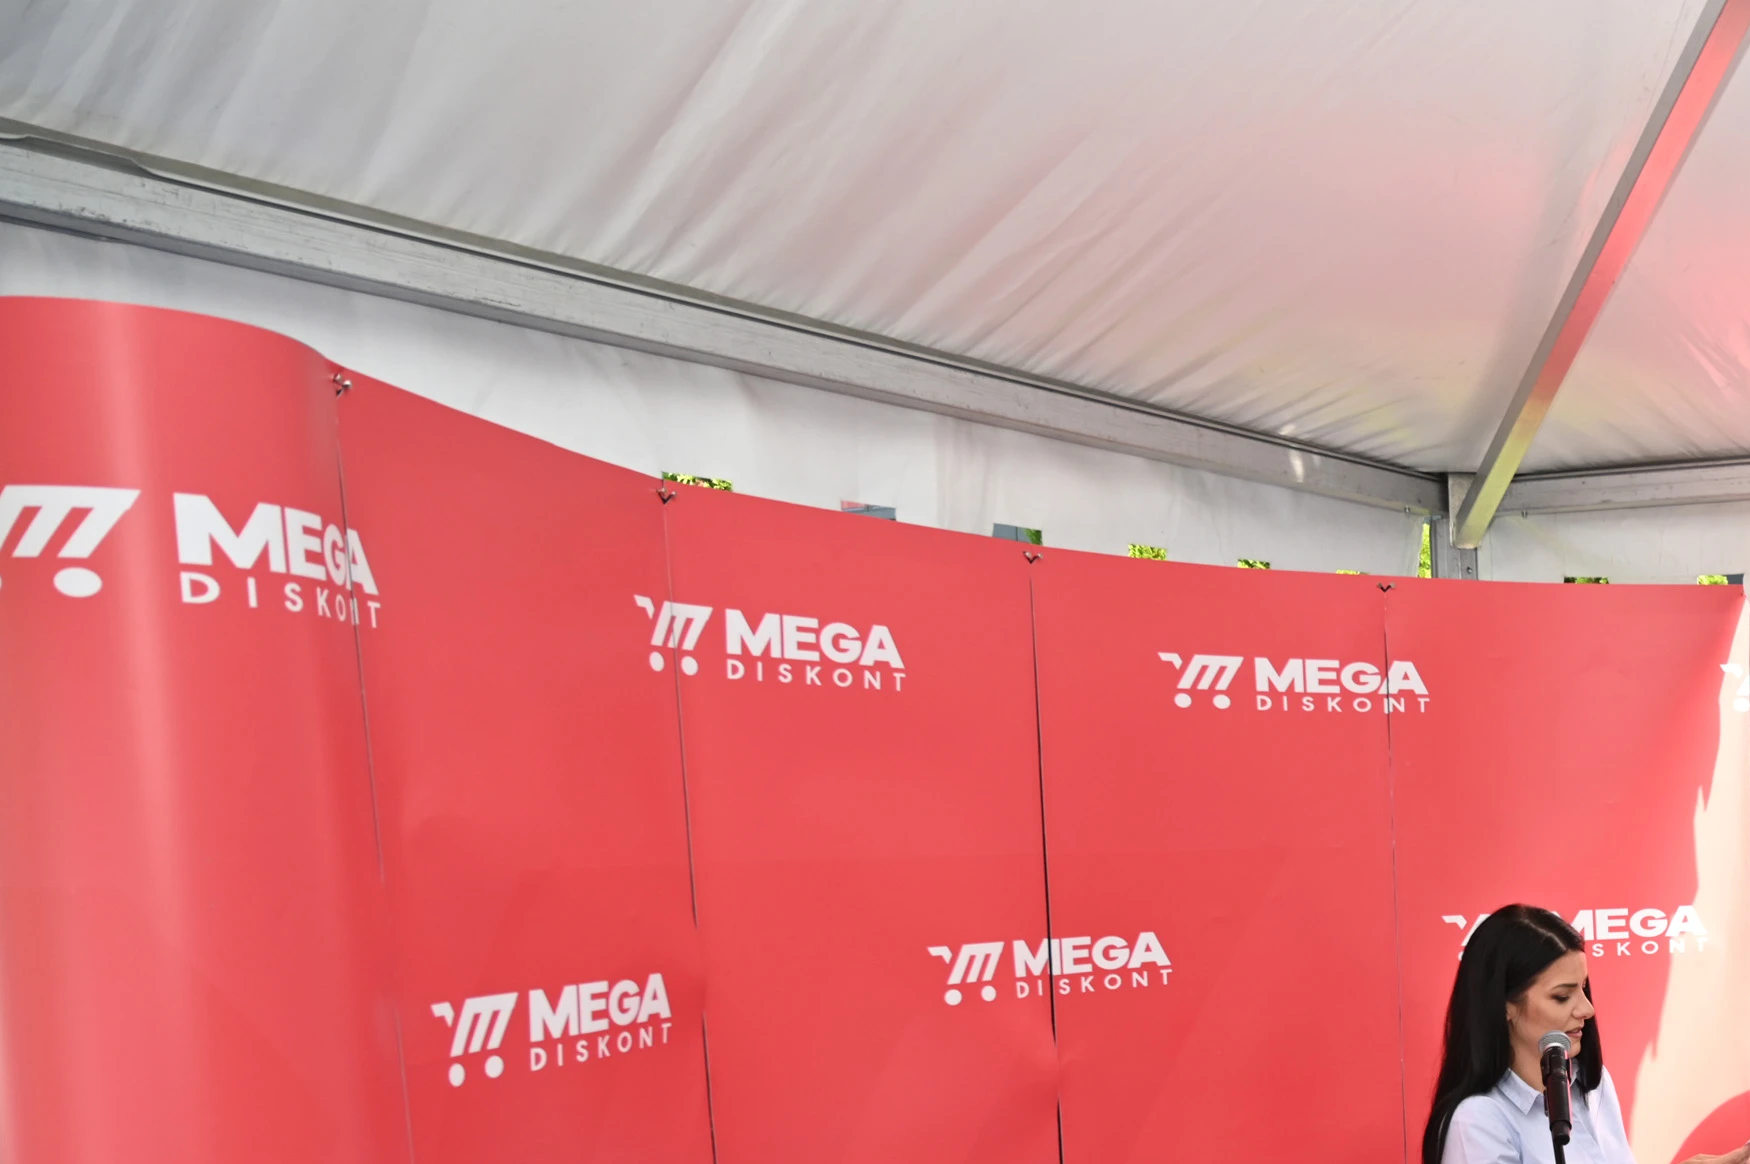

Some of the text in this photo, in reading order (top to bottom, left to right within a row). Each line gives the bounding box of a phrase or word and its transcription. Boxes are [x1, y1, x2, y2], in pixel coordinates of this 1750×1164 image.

[172, 492, 379, 596] MEGA
[179, 571, 382, 629] DISKONT
[725, 608, 905, 668] MEGA
[726, 658, 906, 692] DISKONT
[1254, 656, 1429, 695] MEGA
[1256, 694, 1430, 714] DISKONT
[1012, 931, 1172, 978] MEGA
[1591, 937, 1709, 958] SKONT
[1016, 968, 1173, 999] DISKONT
[529, 973, 672, 1043] MEGA
[530, 1022, 672, 1071] DISKONT
